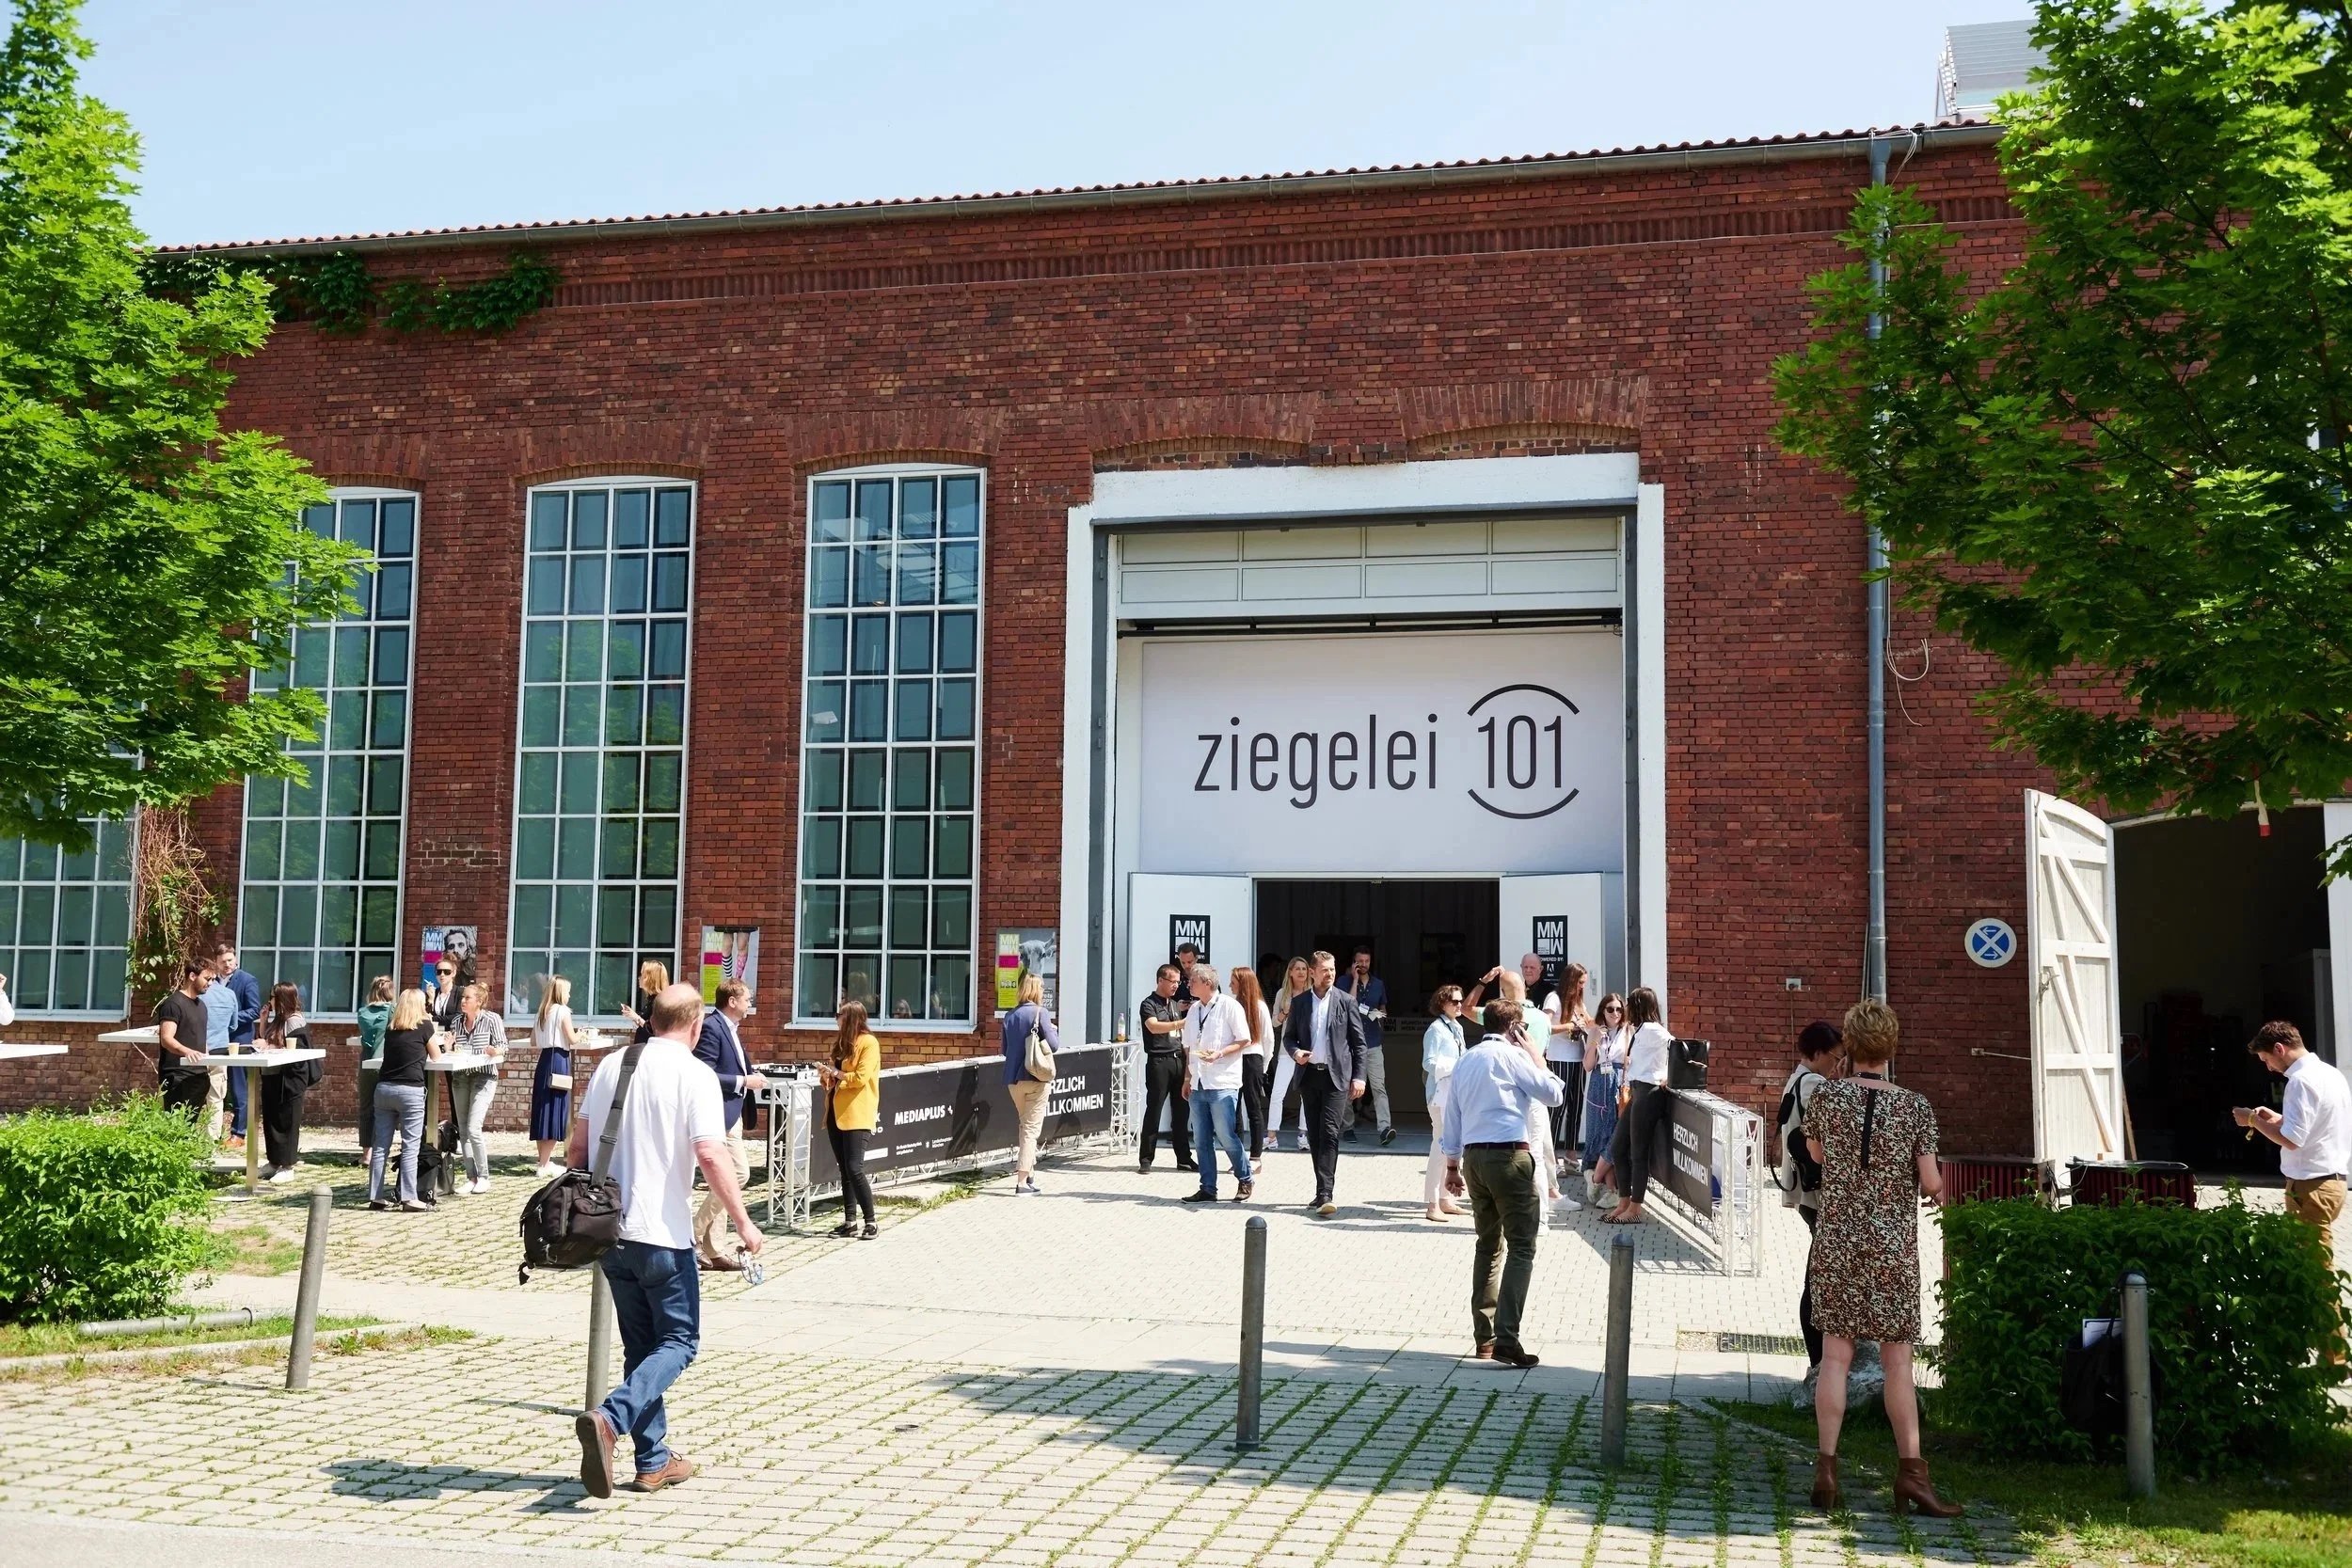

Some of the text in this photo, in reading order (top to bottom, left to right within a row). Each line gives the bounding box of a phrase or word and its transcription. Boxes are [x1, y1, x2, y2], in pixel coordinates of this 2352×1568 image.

[1195, 713, 1562, 809] ziegelei 101
[1175, 920, 1205, 936] MM
[1537, 921, 1564, 938] MM
[1050, 1075, 1085, 1095] RZLICH
[894, 1105, 946, 1125] MEDIAPLUS
[1044, 1093, 1104, 1117] ILLKOMMEN
[1673, 1122, 1699, 1153] HERZLICH
[1672, 1148, 1708, 1186] WILLKOMMEN
